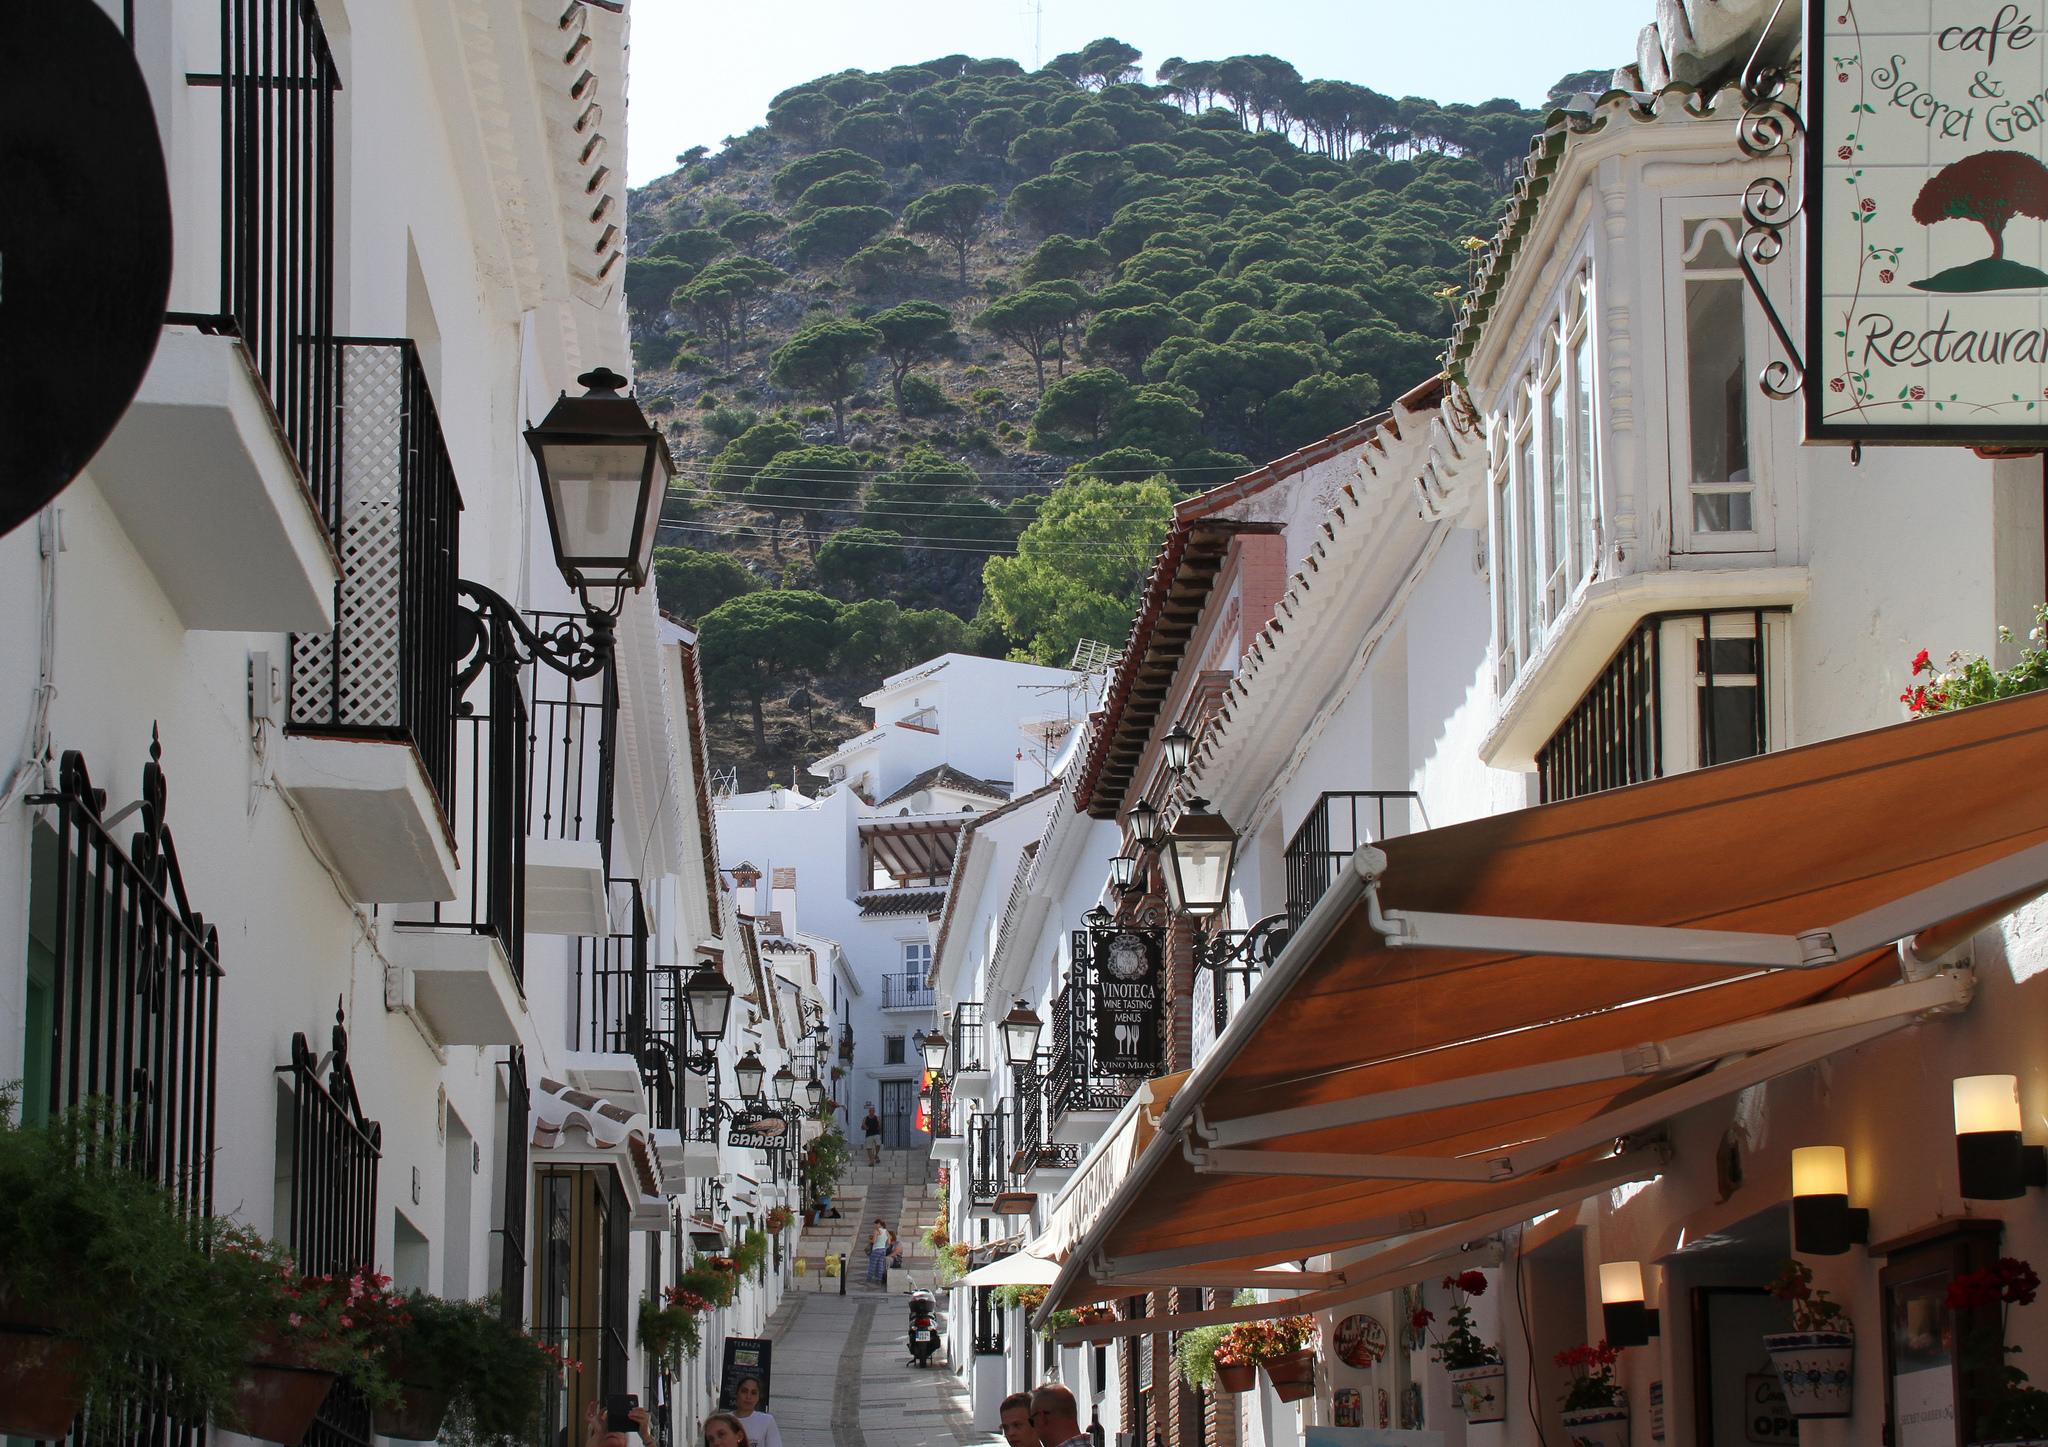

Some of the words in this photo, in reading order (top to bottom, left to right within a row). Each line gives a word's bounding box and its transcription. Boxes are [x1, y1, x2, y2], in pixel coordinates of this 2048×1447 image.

[1938, 4, 2037, 67] café
[1968, 70, 2005, 99] &
[1871, 54, 1974, 142] Secret
[1985, 86, 2048, 143] Gar
[1101, 982, 1156, 999] VINOTECA
[1074, 933, 1086, 1075] RESTAURANT
[1103, 999, 1121, 1009] WINE
[1123, 999, 1153, 1010] TASTING
[1114, 1013, 1141, 1023] MENUS
[1101, 1061, 1126, 1069] VINO
[729, 1133, 786, 1147] GAMBA
[1754, 1415, 1799, 1438] OPE
